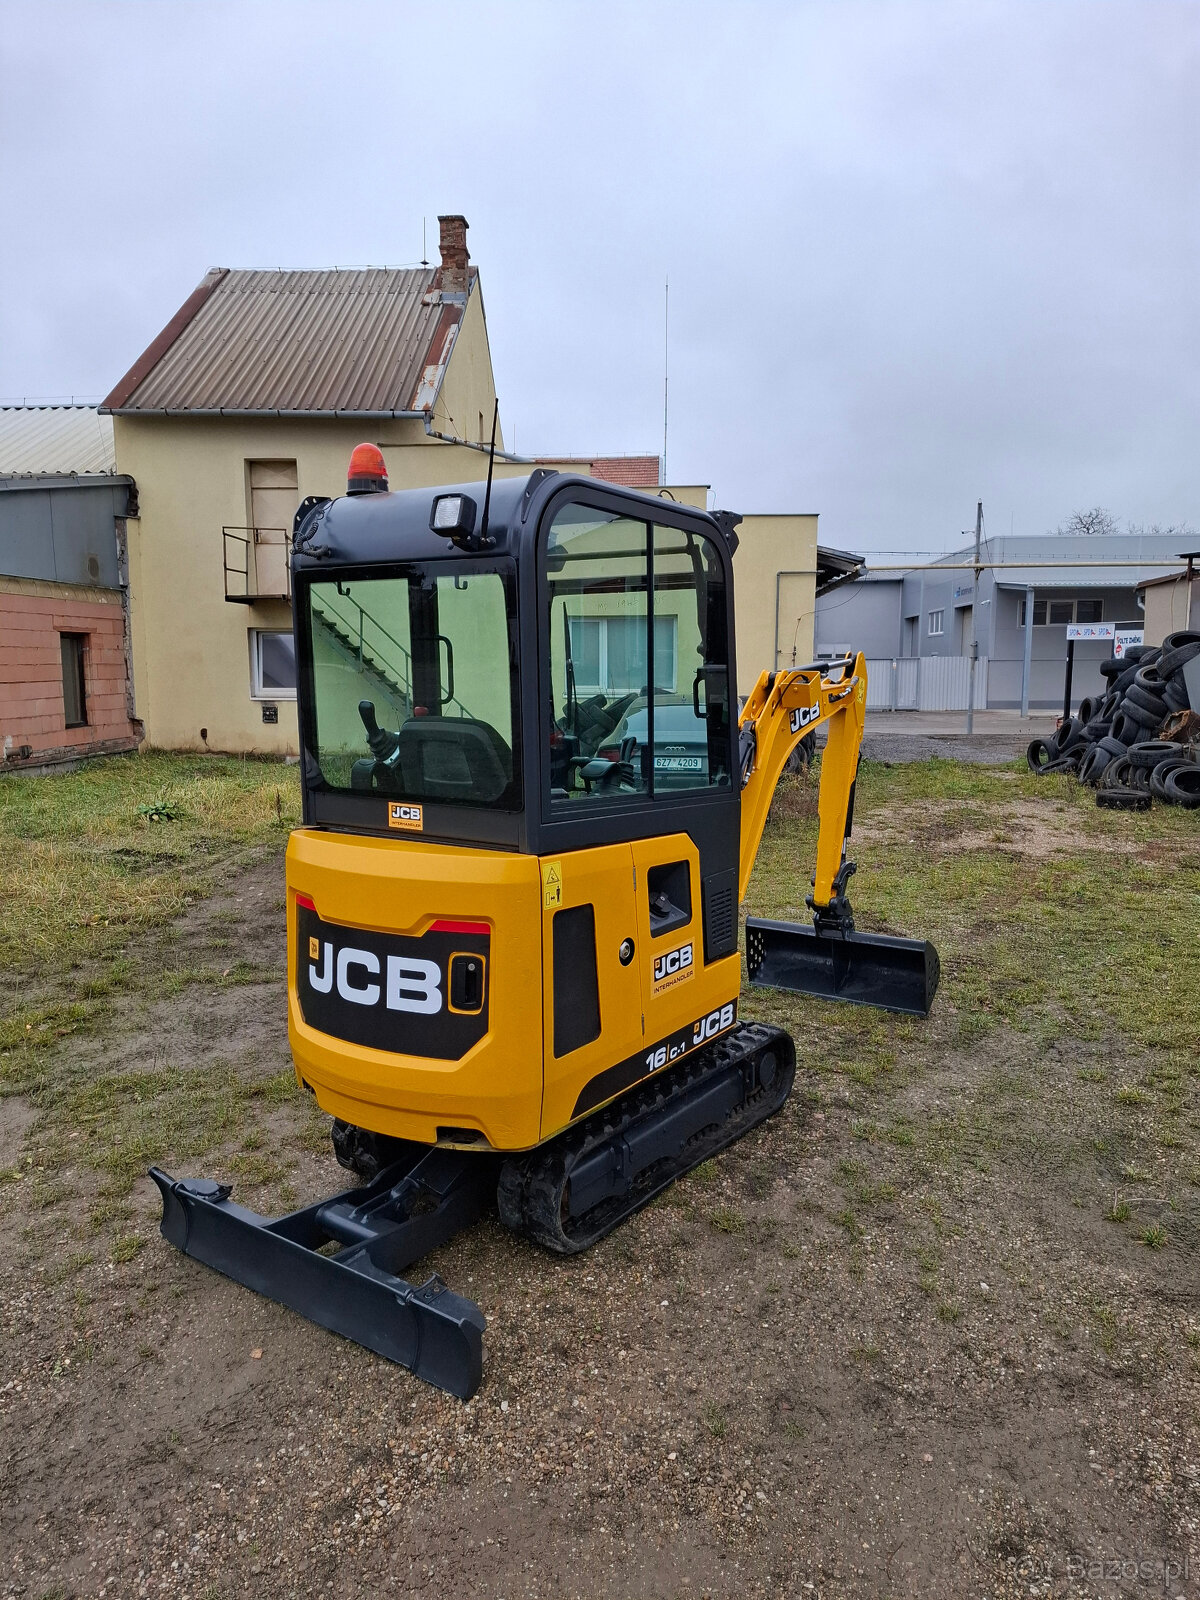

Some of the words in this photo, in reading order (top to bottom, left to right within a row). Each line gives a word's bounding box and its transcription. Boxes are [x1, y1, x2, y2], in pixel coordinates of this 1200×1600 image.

[656, 758, 672, 767] 6Z7
[677, 758, 698, 767] 4209
[392, 806, 420, 820] JCB
[655, 945, 693, 979] JCB
[309, 941, 443, 1015] JCB
[653, 970, 693, 994] INTERHANDLER
[692, 1003, 734, 1045] JCB
